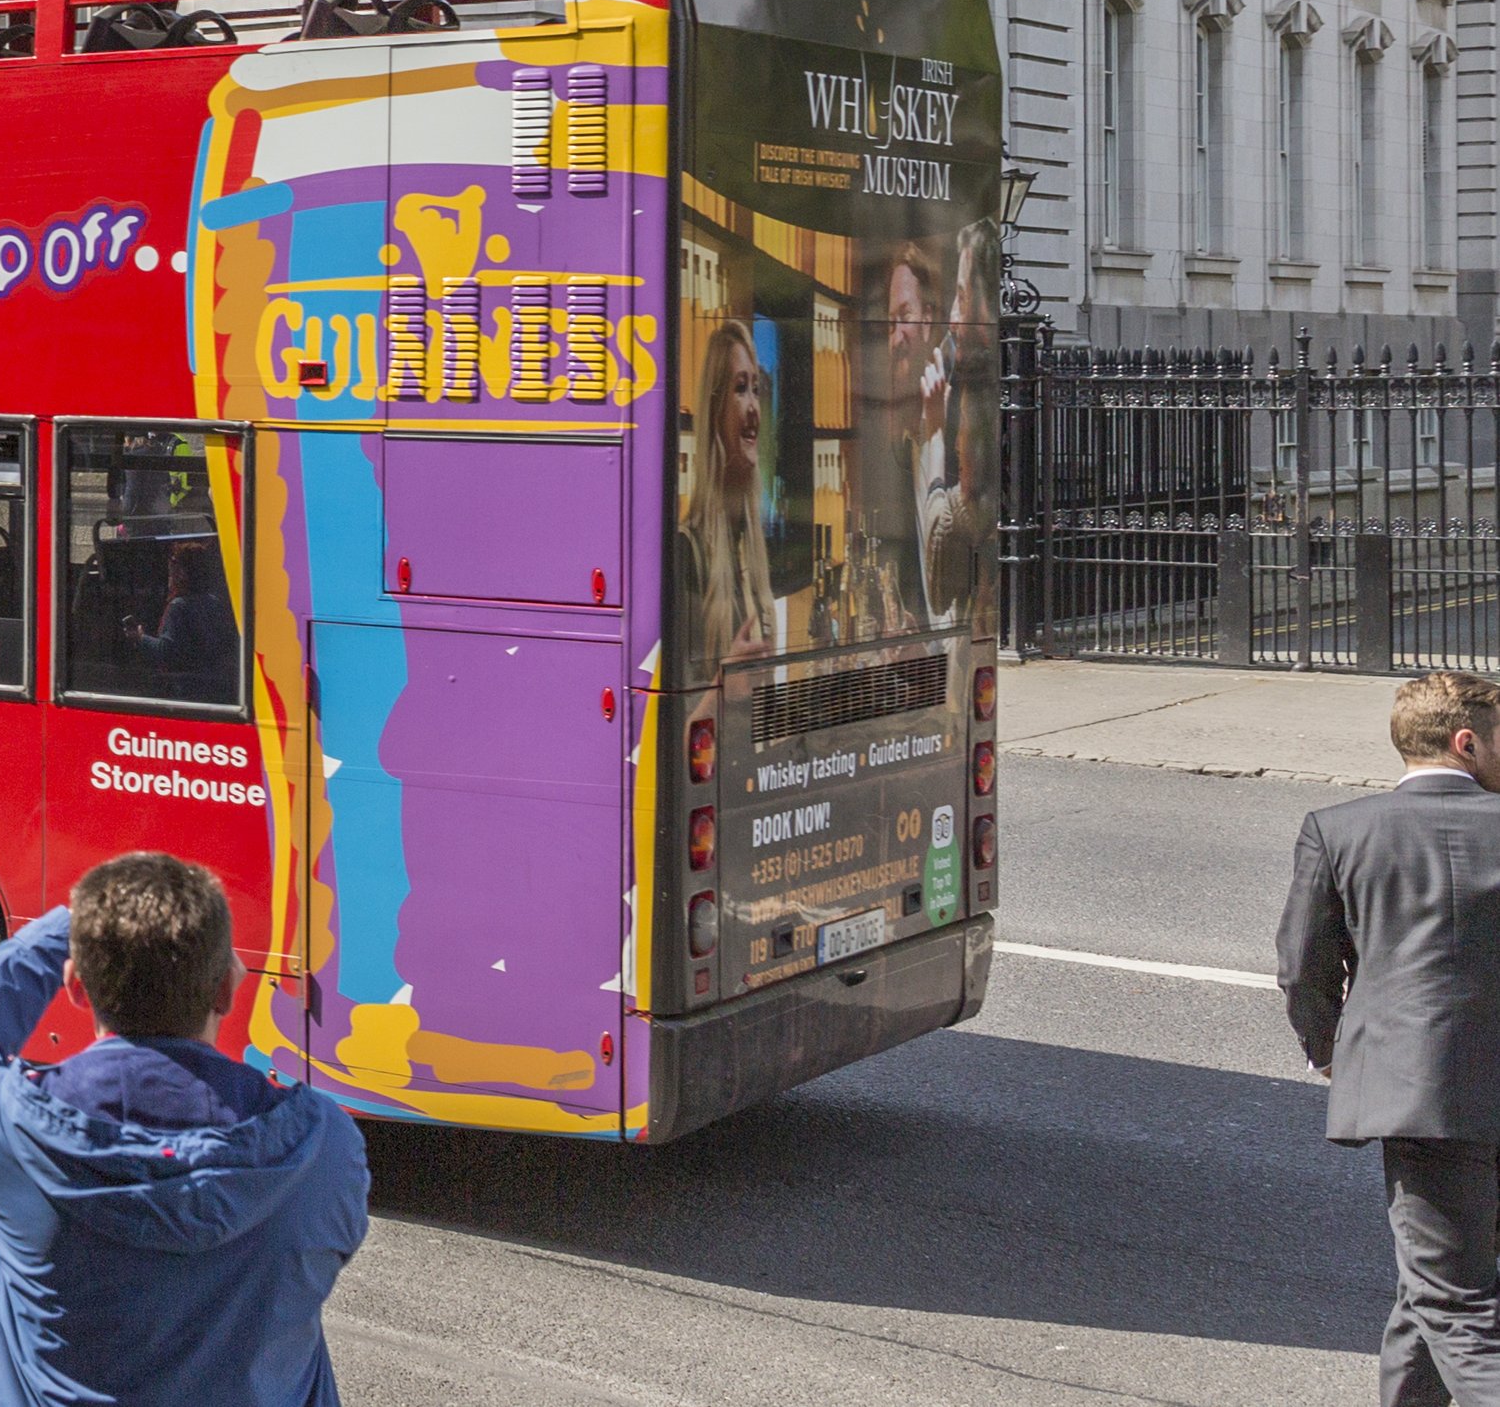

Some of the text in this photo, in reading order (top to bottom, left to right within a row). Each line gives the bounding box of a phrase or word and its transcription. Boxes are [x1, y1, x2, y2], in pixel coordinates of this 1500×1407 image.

[922, 57, 953, 86] IRISH
[862, 154, 951, 201] MUSEUM
[107, 727, 249, 768] Guinness
[757, 733, 942, 792] Whiskey tasting Guided tours
[90, 761, 267, 807] Storehouse
[752, 802, 831, 847] BOOK NOW!
[752, 856, 782, 885] +353
[810, 843, 832, 870] 525
[834, 835, 864, 863] 0970
